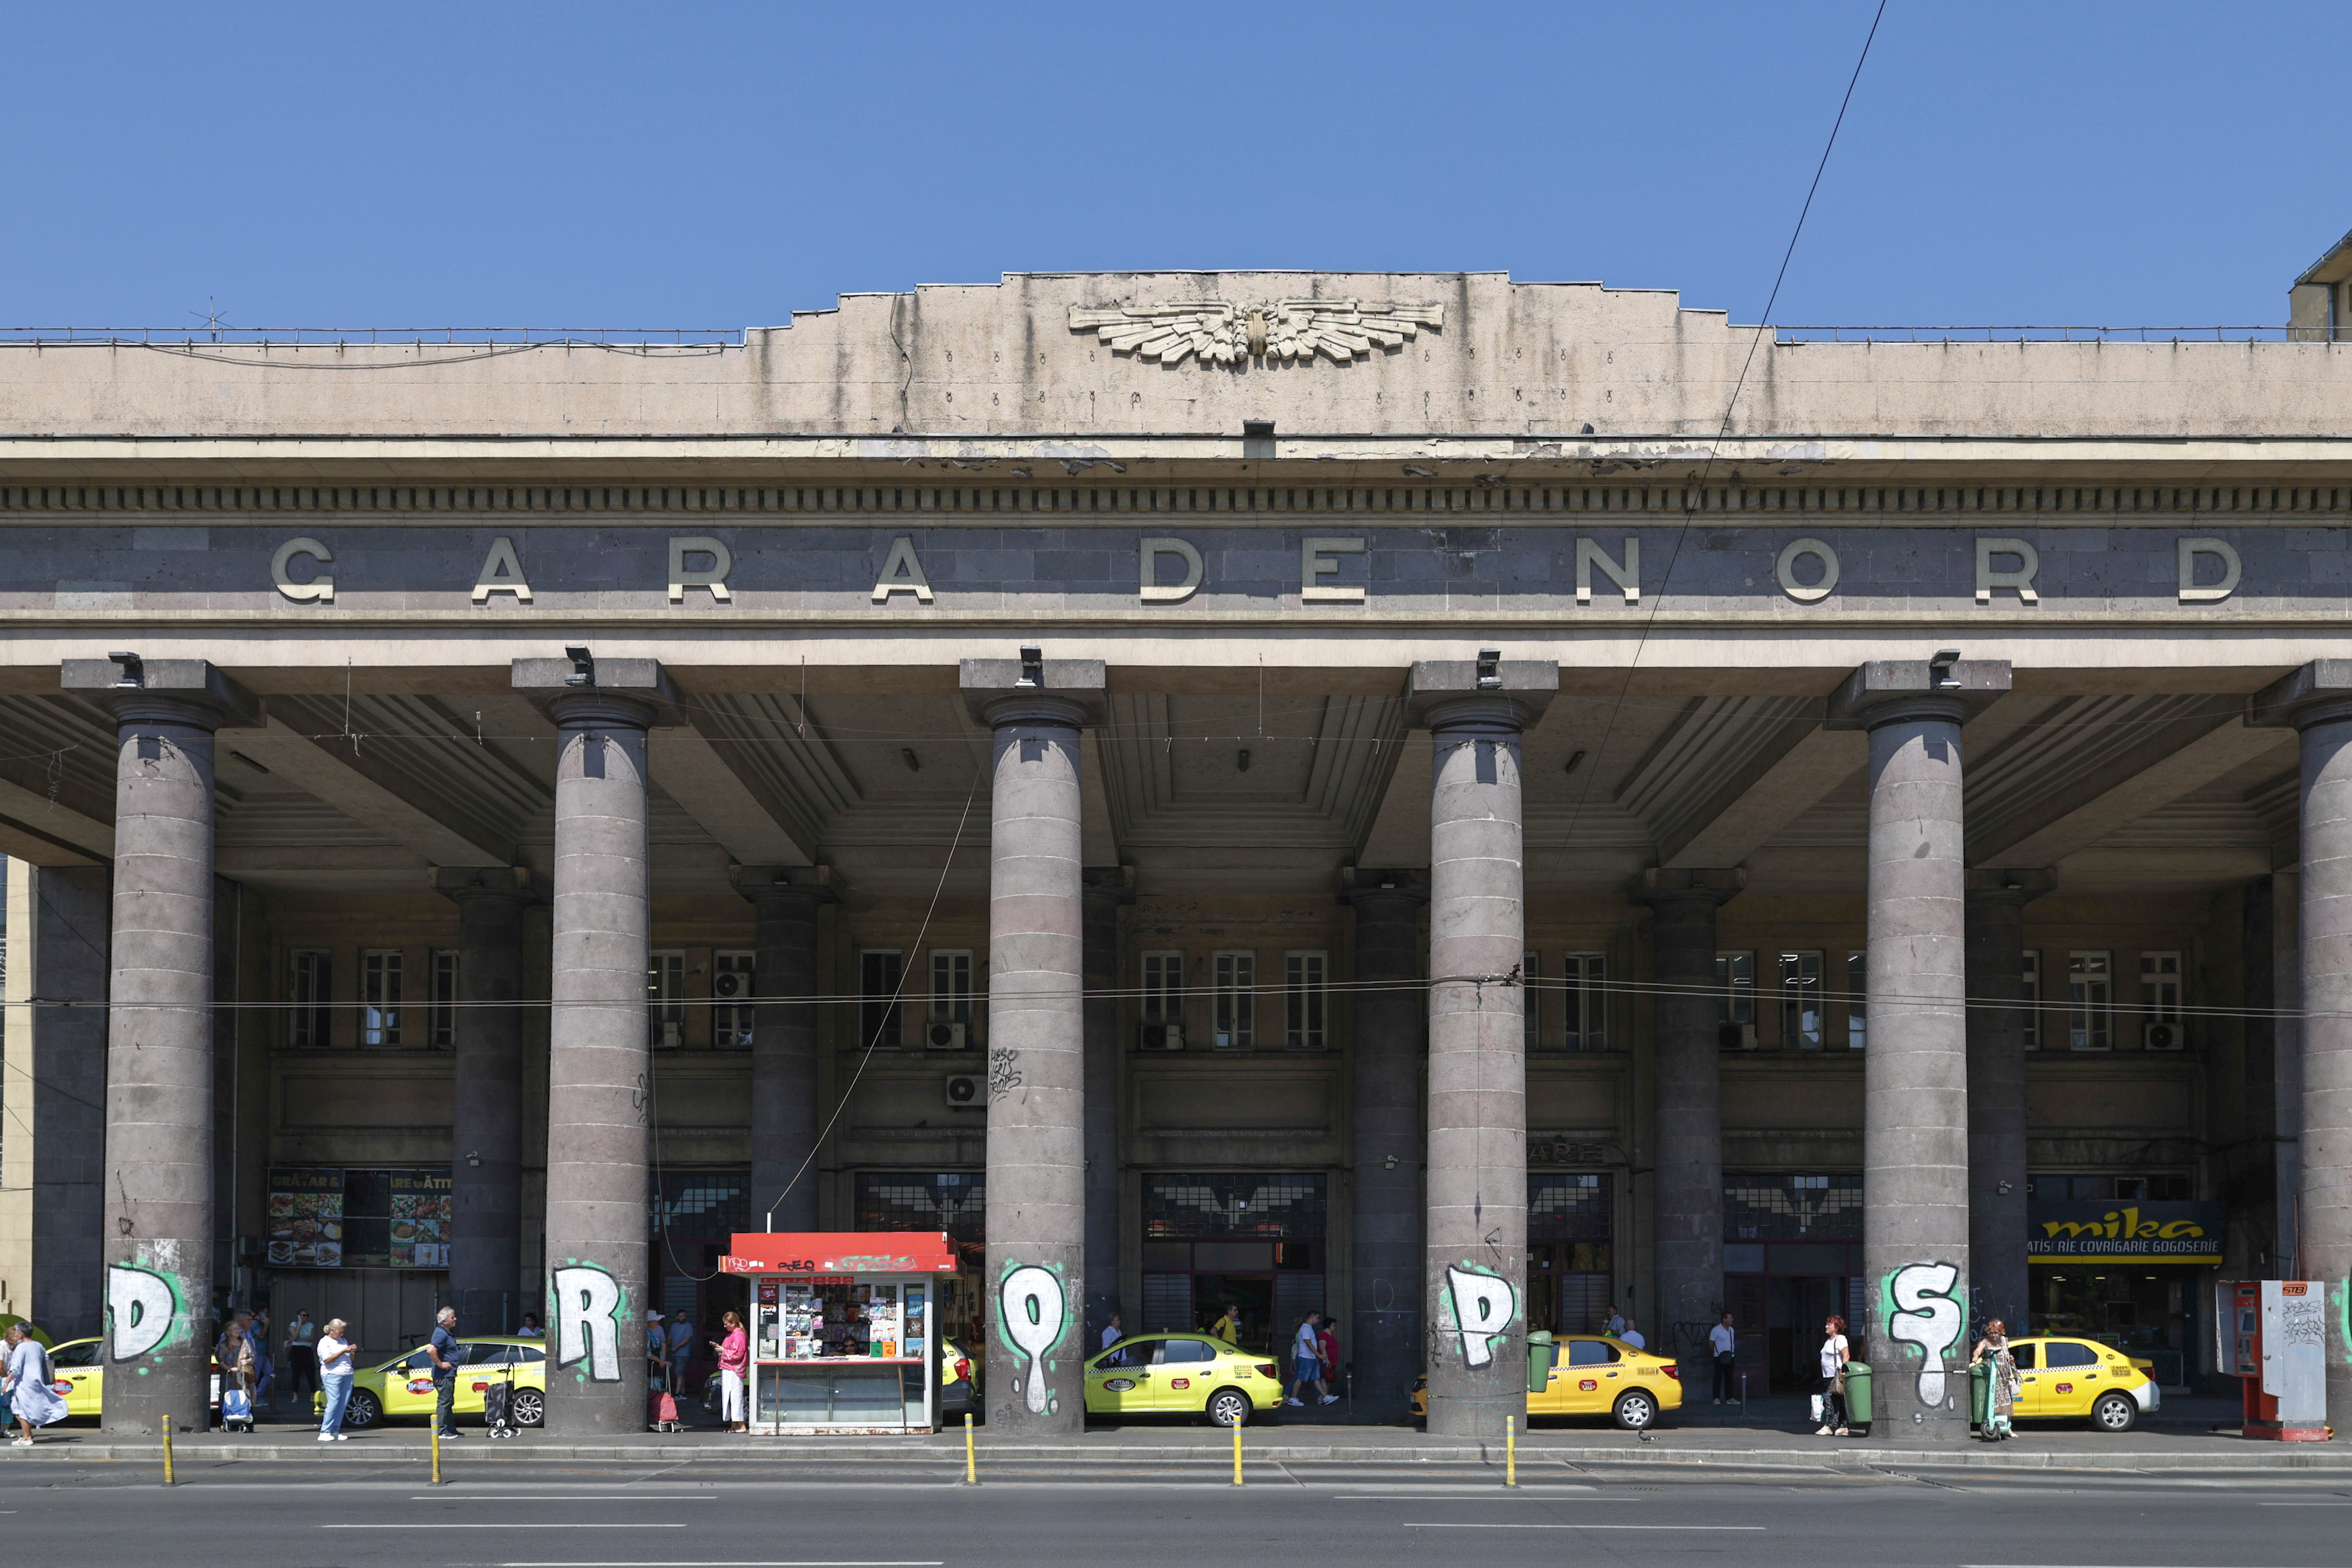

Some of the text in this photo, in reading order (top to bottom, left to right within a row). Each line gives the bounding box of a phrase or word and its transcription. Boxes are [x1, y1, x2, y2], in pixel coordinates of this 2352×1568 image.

[271, 536, 2242, 601] GARA DE NORD
[2042, 1206, 2204, 1239] mika
